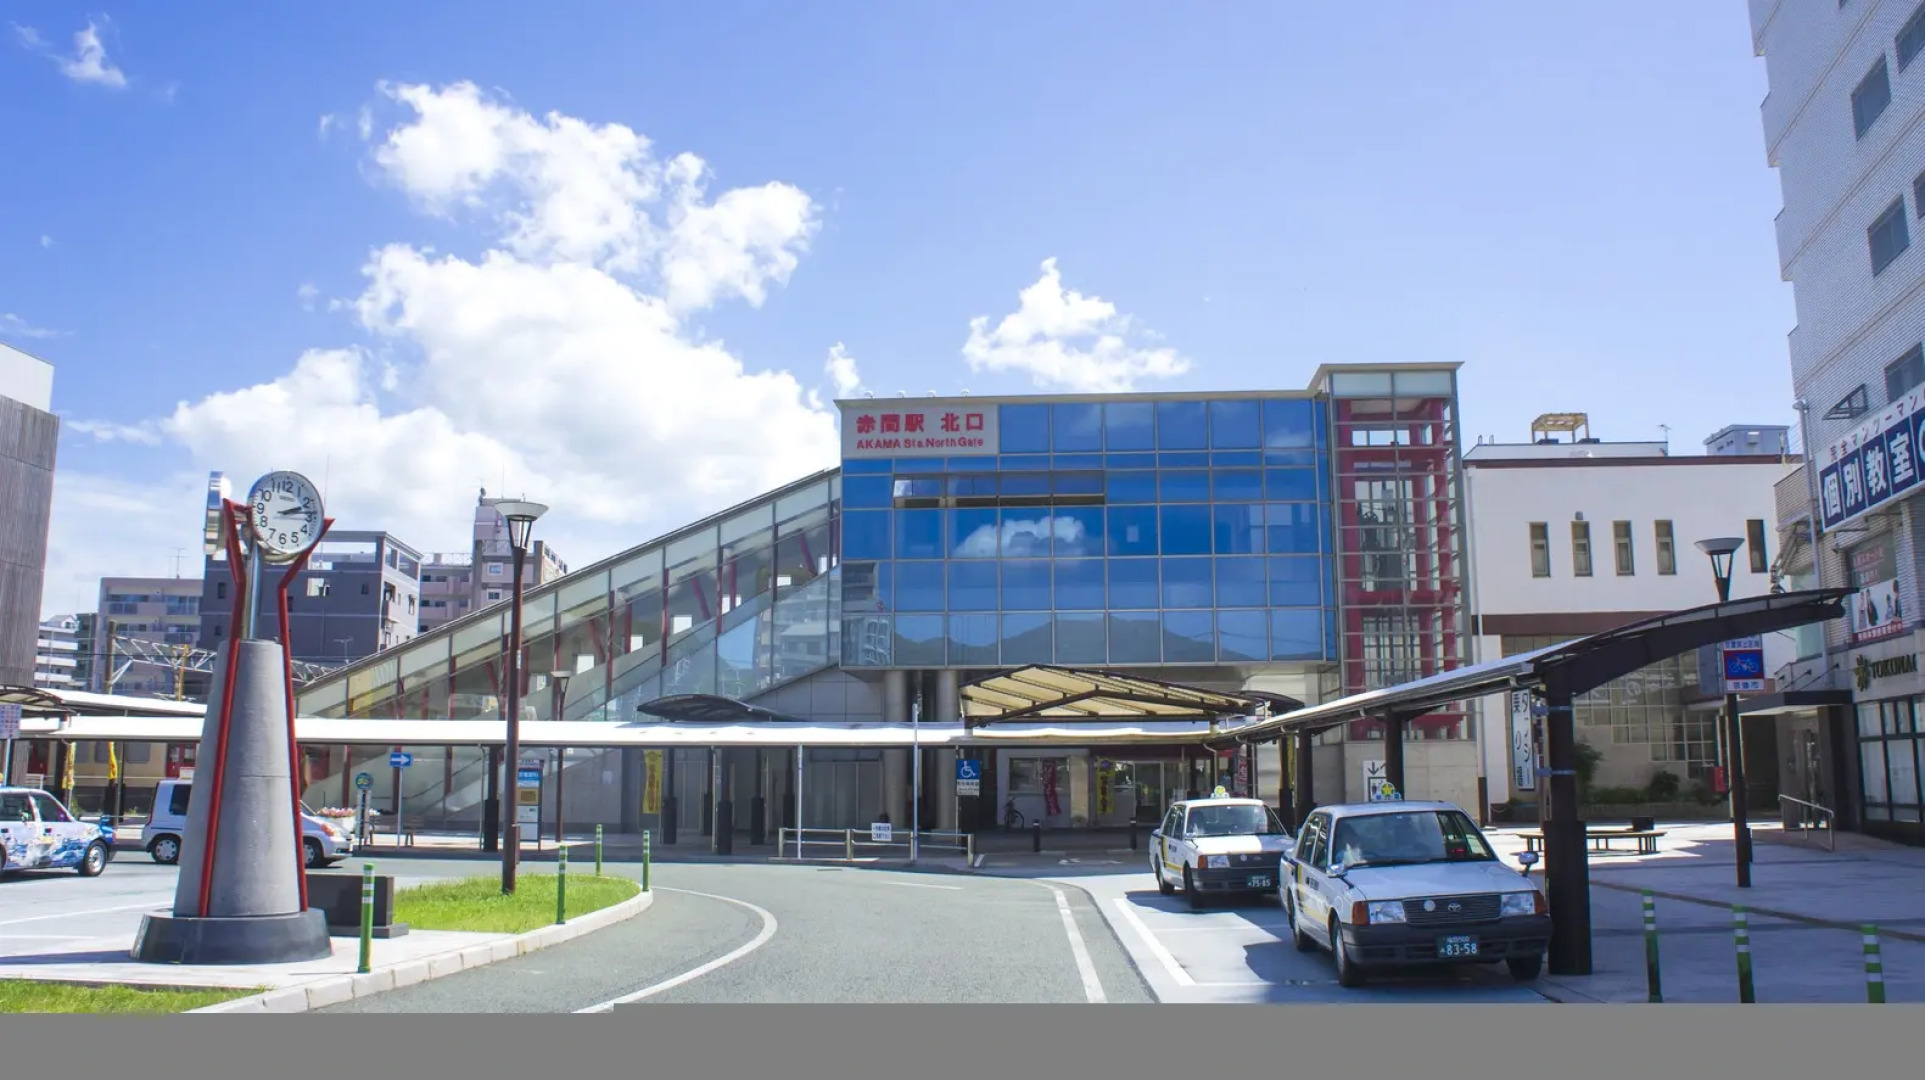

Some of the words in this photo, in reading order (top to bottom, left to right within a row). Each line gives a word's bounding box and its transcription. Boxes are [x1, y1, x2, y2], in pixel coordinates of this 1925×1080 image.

[856, 413, 925, 434] 赤間駅
[941, 412, 984, 432] 北口
[1829, 387, 1925, 463] 完全マンツーマン
[857, 439, 901, 449] AKAMA
[271, 478, 281, 493] 11
[282, 481, 293, 493] 12
[259, 489, 271, 501] 10
[303, 497, 310, 508] 2
[256, 503, 264, 514] 9
[260, 516, 267, 527] 8
[269, 528, 276, 539] 7
[300, 525, 307, 534] 4
[279, 533, 286, 544] 6
[291, 532, 298, 543] 5
